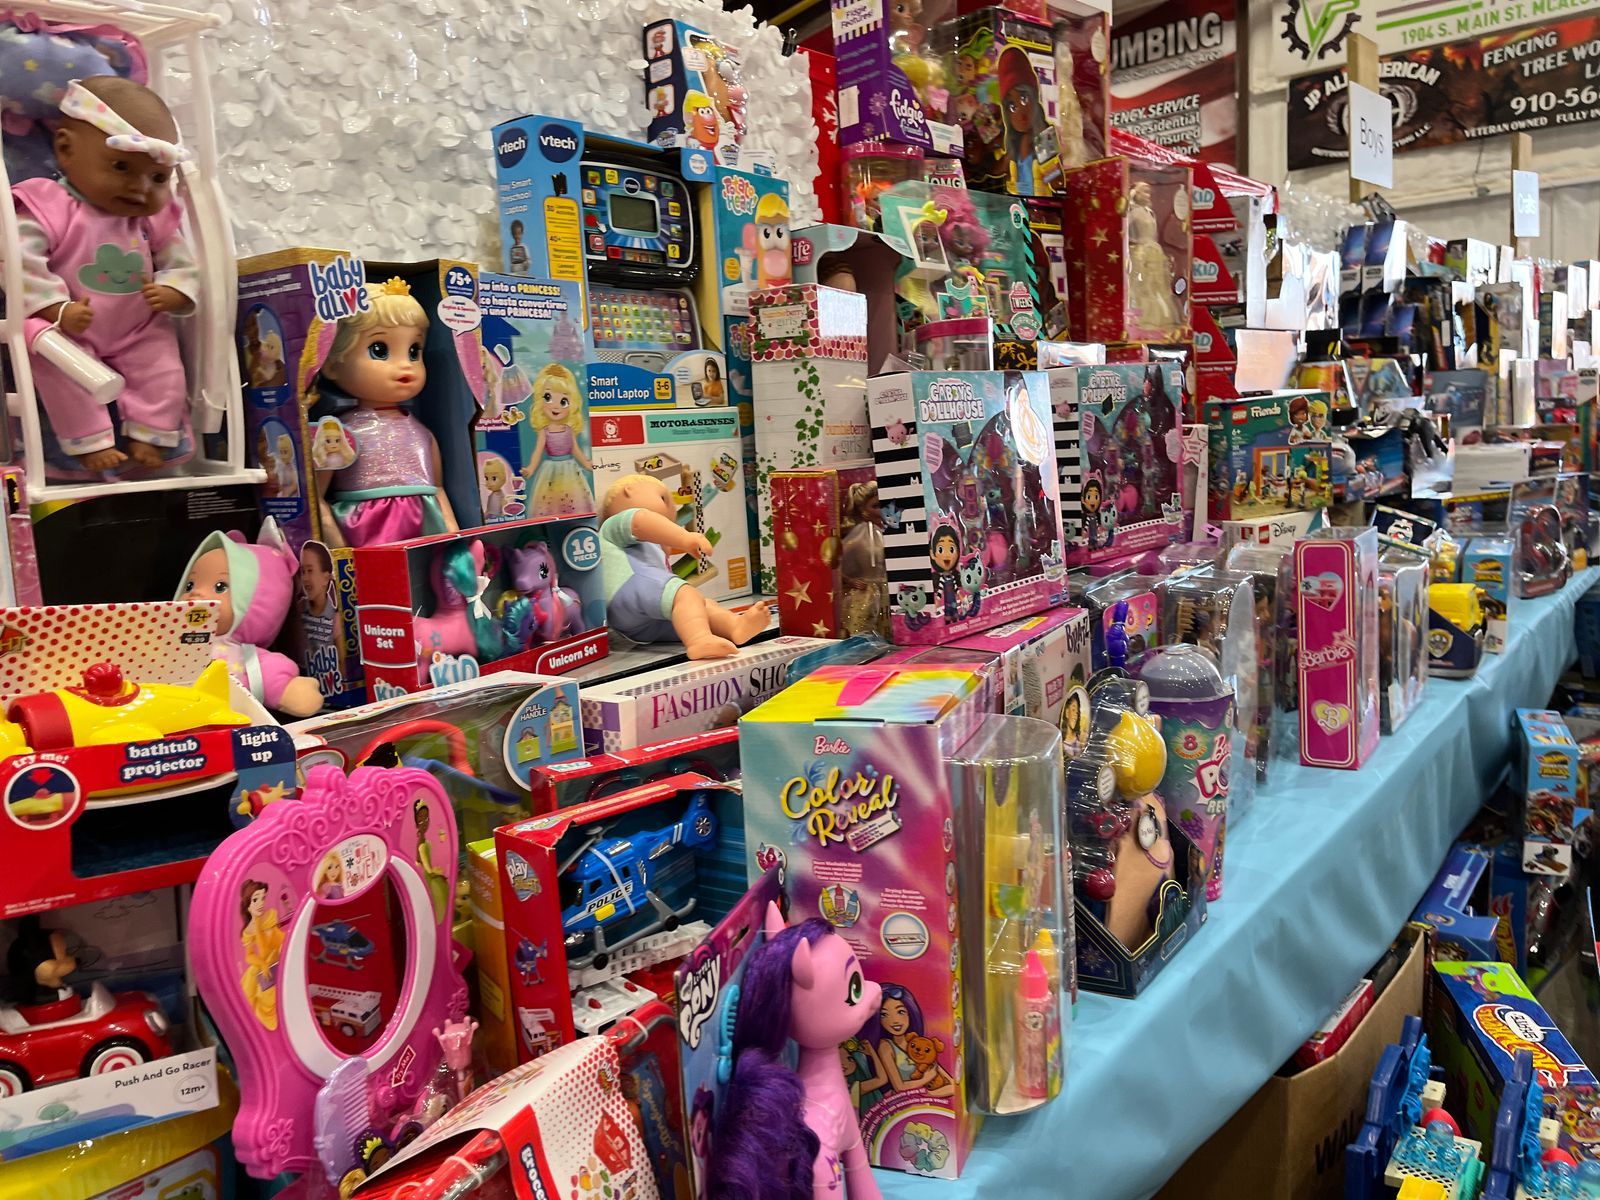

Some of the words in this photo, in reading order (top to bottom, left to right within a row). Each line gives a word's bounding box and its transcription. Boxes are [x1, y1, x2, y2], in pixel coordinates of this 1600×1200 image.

[1402, 27, 1433, 44] 1904
[1457, 11, 1500, 32] MAIN
[1504, 4, 1528, 21] ST.
[1111, 12, 1222, 70] UMBING
[1483, 31, 1558, 68] FENCING
[1521, 50, 1569, 77] TREE
[1572, 40, 1600, 61] WO
[1304, 89, 1321, 111] JP
[1379, 61, 1441, 86] ERICAN
[890, 89, 925, 127] fidgie
[1510, 85, 1600, 115] 910-56
[1110, 111, 1147, 126] GENCY
[1149, 94, 1200, 117] SERVICE
[1133, 111, 1200, 135] Residential
[1464, 123, 1509, 138] VETERAN
[1511, 116, 1548, 130] OWNED
[1556, 111, 1590, 124] FULLY
[498, 137, 526, 155] vtech
[540, 135, 576, 150] vtech
[1156, 129, 1200, 145] Insured
[1360, 117, 1384, 158] Boys
[723, 176, 756, 198] Potato
[793, 240, 812, 258] ife
[310, 258, 364, 293] baby
[449, 271, 472, 286] 75+
[491, 281, 509, 293] into
[510, 285, 516, 293] a
[517, 283, 561, 296] PRINCESS!
[492, 295, 517, 306] hasta
[518, 299, 567, 311] convertirme
[507, 306, 552, 319] PRINCESA!
[591, 375, 619, 386] Smart
[656, 381, 670, 390] 3-6
[589, 388, 615, 400] chool
[617, 388, 650, 400] Laptop
[930, 383, 973, 400] GABBY'S
[920, 400, 985, 422] DOLLHOUSE
[1250, 402, 1282, 418] Friends
[650, 417, 736, 428] MOTOR&SENSES
[1231, 428, 1242, 436] 6+
[571, 536, 596, 556] 16
[573, 552, 598, 562] PIECES
[188, 613, 206, 623] 12+
[364, 624, 405, 638] Unicorn
[376, 637, 394, 649] Set
[306, 646, 338, 677] baby
[548, 650, 584, 669] Unicorn
[584, 643, 598, 658] Set
[1301, 642, 1351, 671] Barbie
[651, 675, 744, 730] FASHION
[749, 663, 788, 698] SHO
[520, 708, 547, 721] HANDLE
[525, 703, 542, 714] PULL
[240, 731, 279, 746] light
[814, 735, 851, 755] Barbie
[1183, 734, 1198, 751] 8
[128, 739, 198, 758] bathtub
[251, 750, 273, 763] up
[12, 756, 37, 769] try
[40, 752, 70, 765] me!
[122, 755, 205, 780] projector
[780, 767, 877, 820] Color
[807, 775, 898, 847] Reveal
[505, 859, 528, 887] play
[587, 883, 633, 913] POLICE
[115, 1077, 140, 1089] Push
[142, 1069, 163, 1082] And
[165, 1066, 180, 1076] Go
[183, 1058, 212, 1072] Racer
[180, 1084, 206, 1096] 12m+
